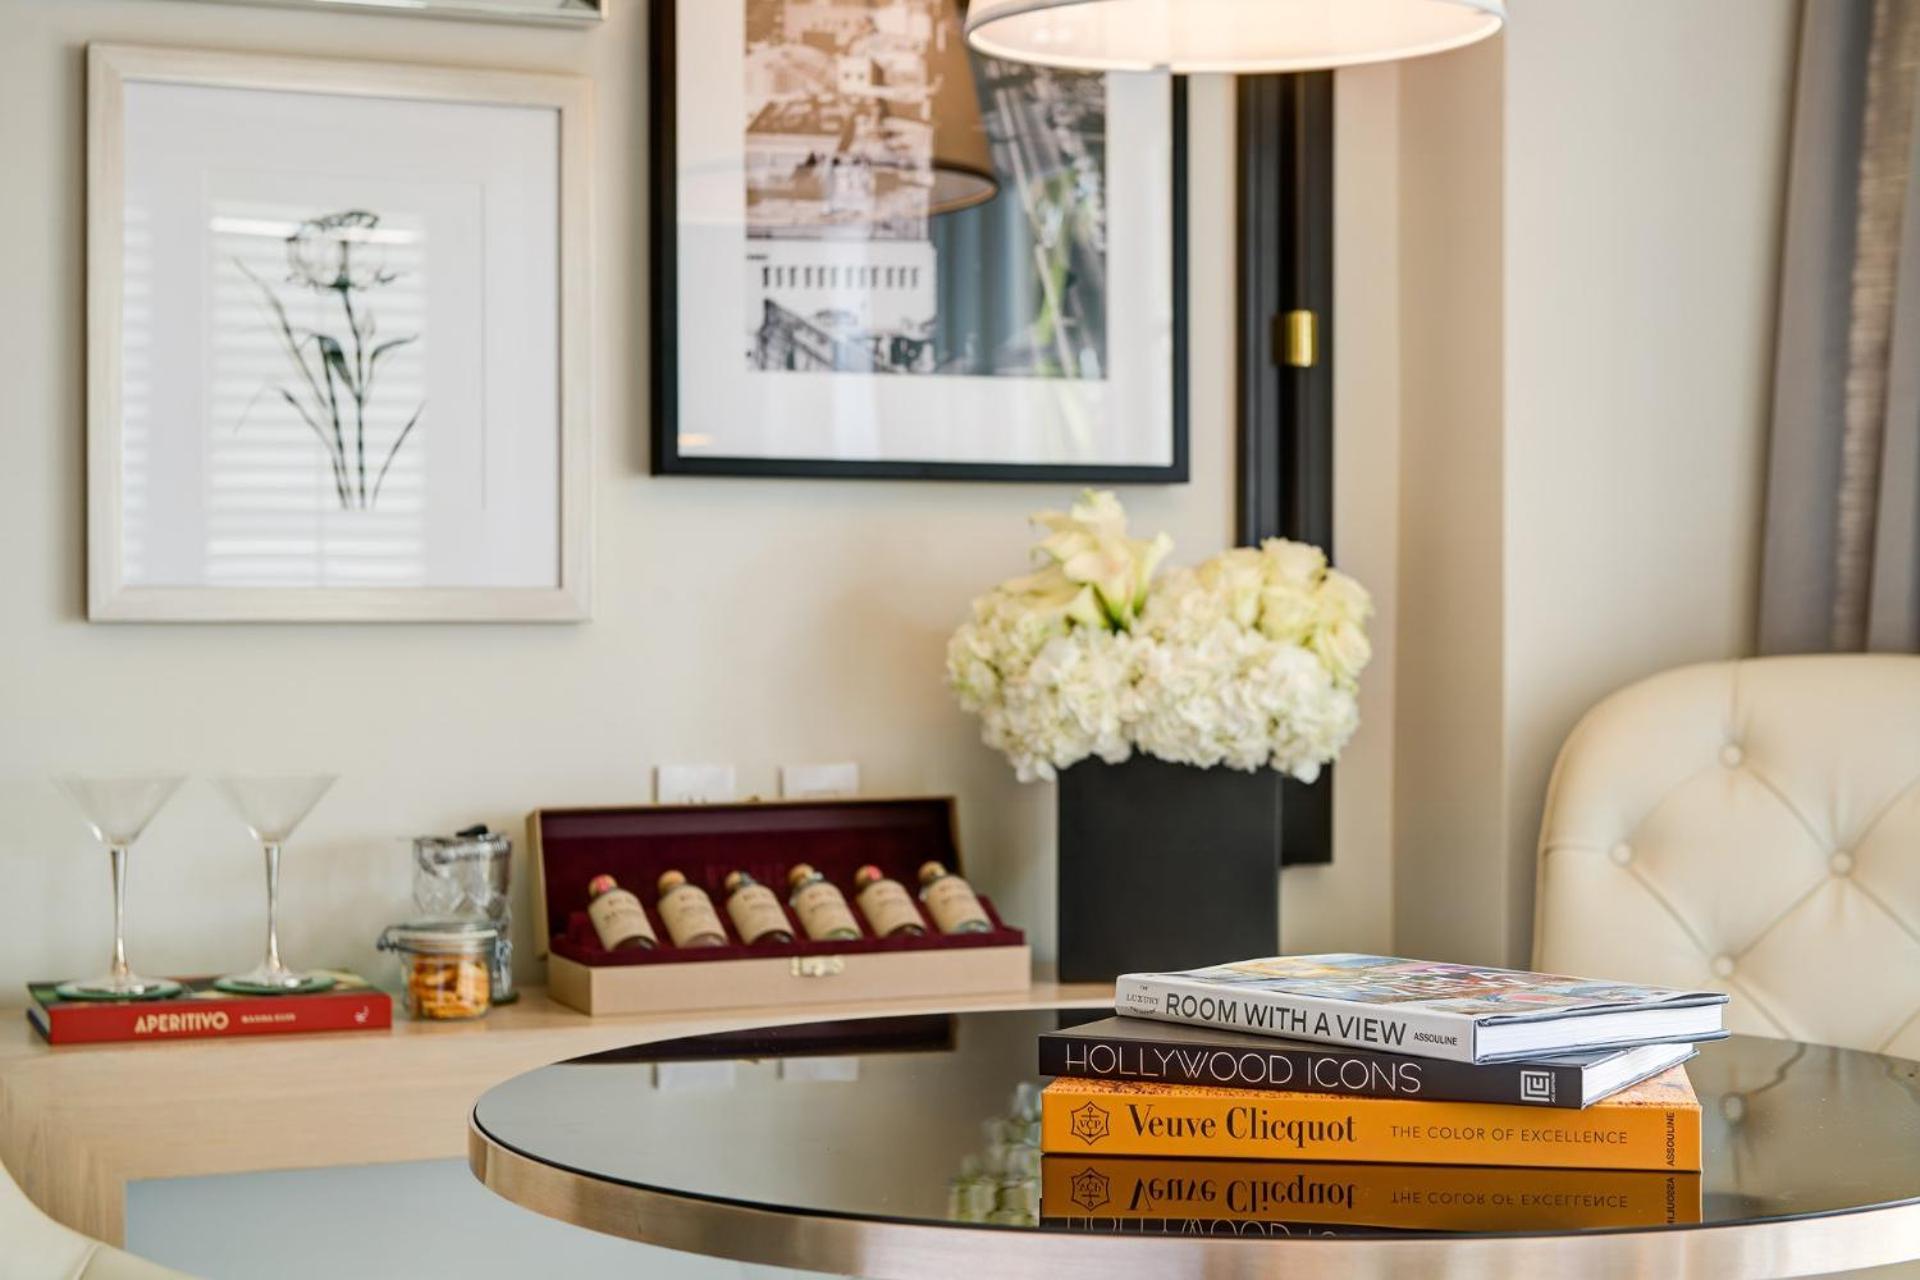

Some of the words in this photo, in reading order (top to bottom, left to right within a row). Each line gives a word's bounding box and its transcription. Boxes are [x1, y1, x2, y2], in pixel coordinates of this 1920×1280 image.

[134, 1011, 230, 1034] APERITIVO
[1166, 992, 1237, 1025] ROOM
[1245, 1002, 1307, 1034] WITH
[1314, 1011, 1331, 1036] A
[1337, 1013, 1407, 1046] VIEW
[1414, 1032, 1458, 1046] ASSOULINE
[1065, 1043, 1293, 1084] HOLLYWOOD
[1306, 1057, 1422, 1094] ICONS
[1079, 1119, 1101, 1130] VCP
[1128, 1103, 1217, 1138] Veuve
[1226, 1106, 1358, 1148] Clicquot
[1391, 1126, 1421, 1138] THE
[1428, 1126, 1486, 1140] COLOR
[1492, 1127, 1515, 1141] OF
[1521, 1128, 1629, 1144] EXCELLENCE
[1665, 1111, 1676, 1167] ASSOULINE
